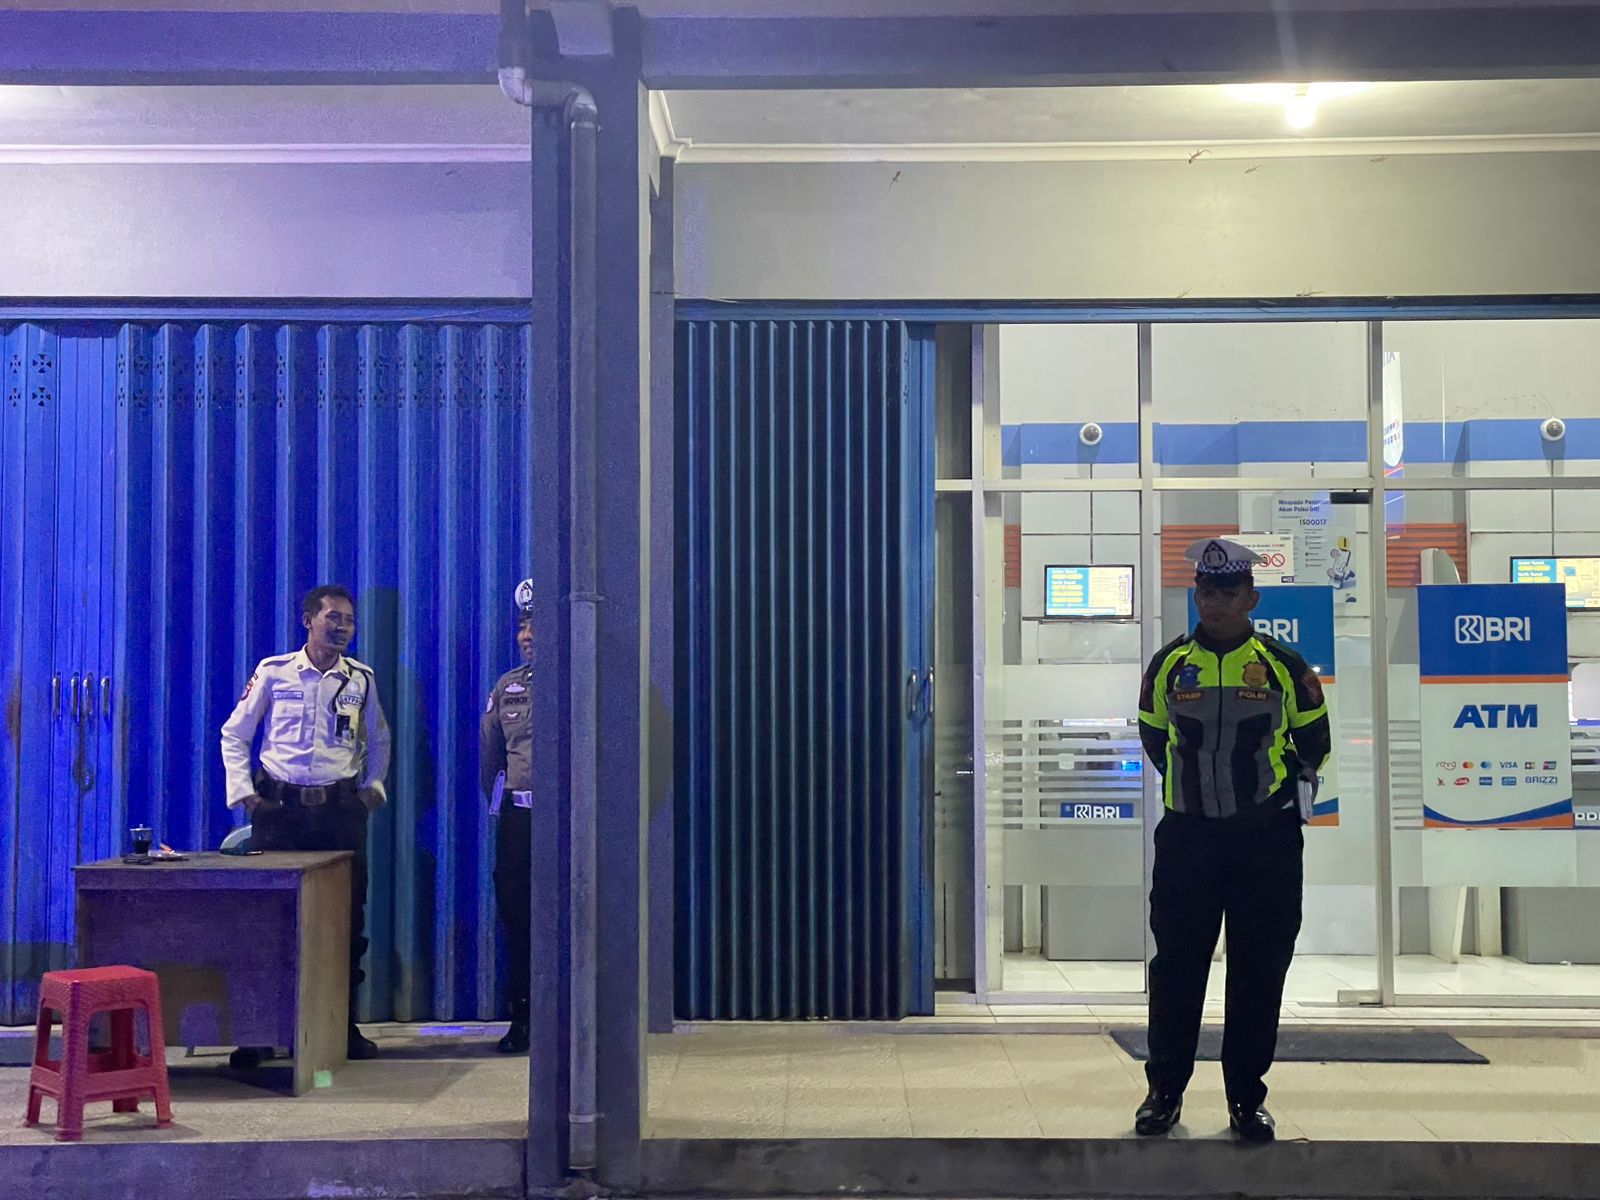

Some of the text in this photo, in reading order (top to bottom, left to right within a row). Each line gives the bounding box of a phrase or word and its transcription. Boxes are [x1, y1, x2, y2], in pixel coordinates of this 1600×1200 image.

[1254, 618, 1298, 642] BRI
[1485, 617, 1531, 641] BRI
[1453, 704, 1538, 728] ATM
[1500, 761, 1518, 769] VISA
[1525, 776, 1558, 784] BRIZZI
[1093, 805, 1120, 818] BRI
